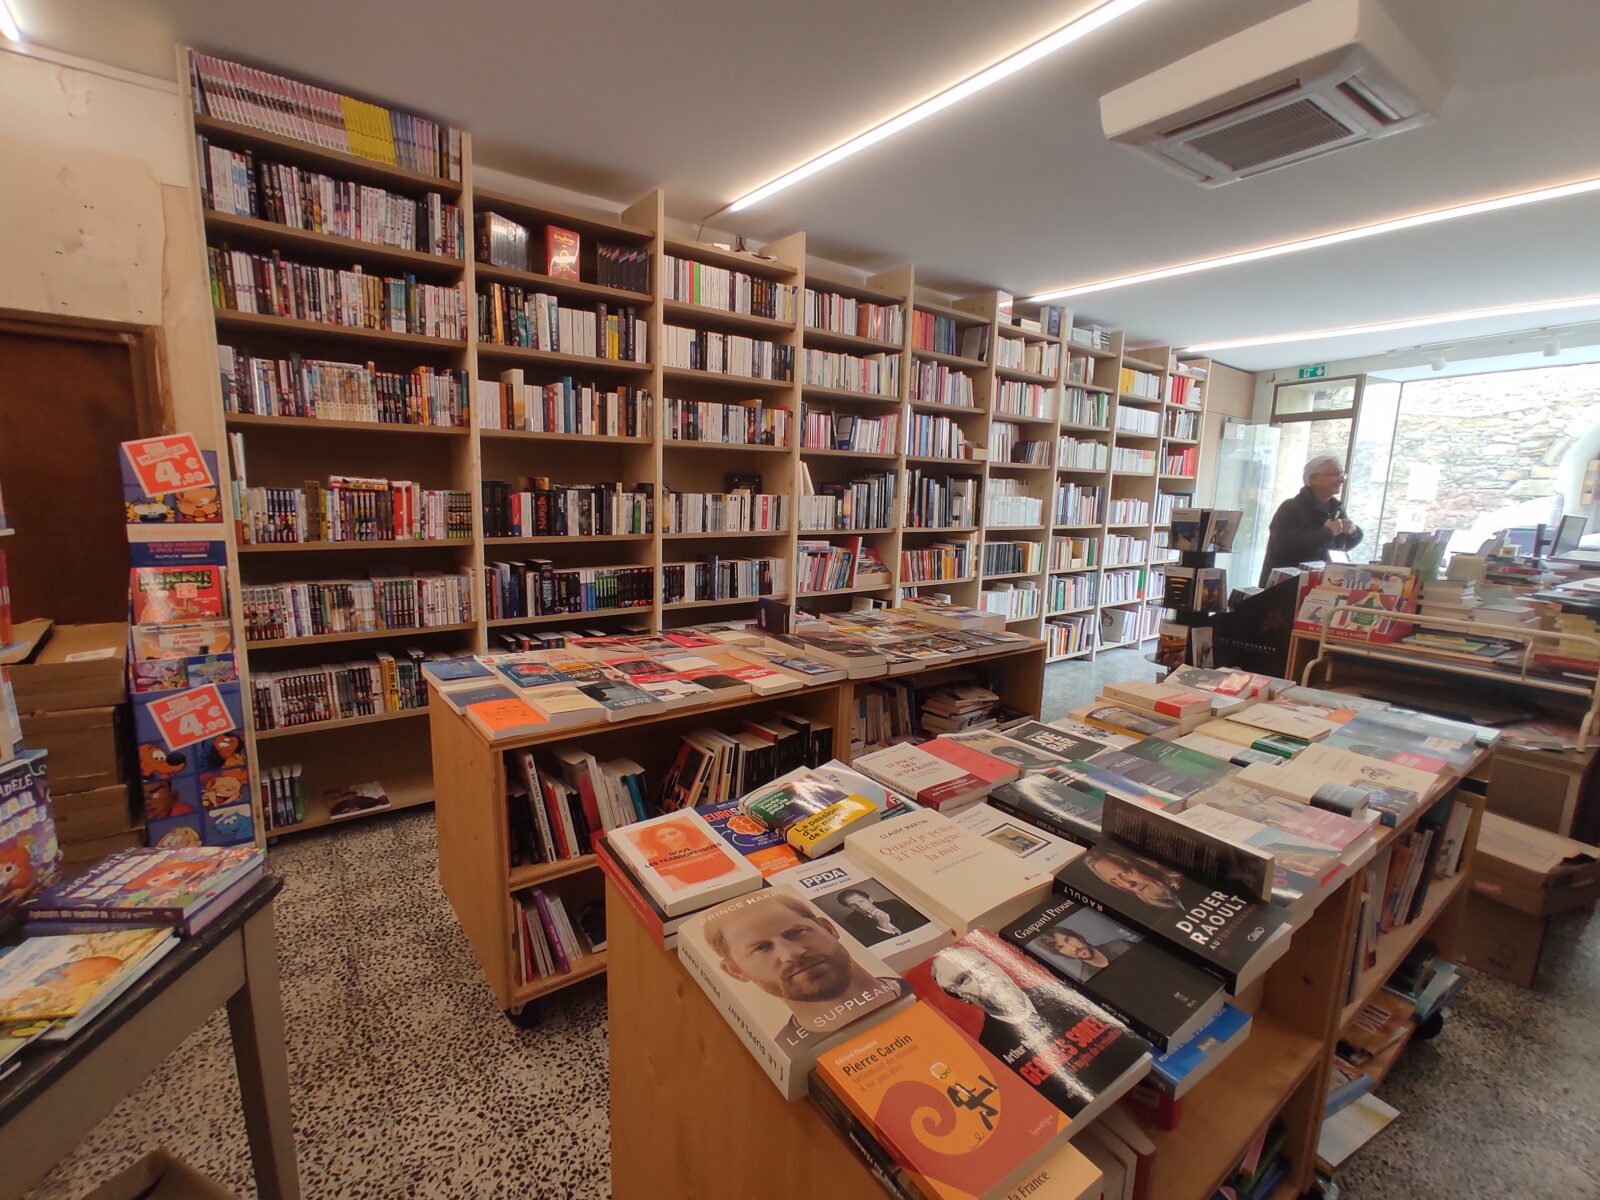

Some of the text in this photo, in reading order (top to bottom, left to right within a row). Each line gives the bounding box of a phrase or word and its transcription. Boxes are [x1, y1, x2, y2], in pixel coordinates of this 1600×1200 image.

[1030, 731, 1062, 746] JOE
[1046, 737, 1079, 752] BAR
[795, 823, 809, 833] La
[808, 806, 840, 827] passion
[802, 821, 821, 837] d'un
[880, 819, 929, 839] CLAUDE MARTIN
[808, 830, 821, 841] de
[879, 836, 918, 856] Quand
[917, 832, 926, 843] je
[644, 860, 659, 869] LES
[896, 854, 904, 863] à
[924, 852, 938, 861] la
[802, 869, 846, 887] PPDA
[1063, 885, 1104, 912] RAOULT
[1014, 899, 1075, 939] Gaspard Proust
[1175, 890, 1229, 933] DIDIER
[1190, 895, 1247, 945] RAOULT
[682, 946, 721, 998] PRINCE HARRY
[786, 978, 901, 1047] LE SUPPLÉANT
[728, 1004, 778, 1070] LE SUPPLÉANT
[843, 1034, 913, 1077] Pierre Cardin
[1002, 1045, 1028, 1065] Arthur
[1019, 1036, 1079, 1087] GEOES
[1017, 1170, 1050, 1199] France
